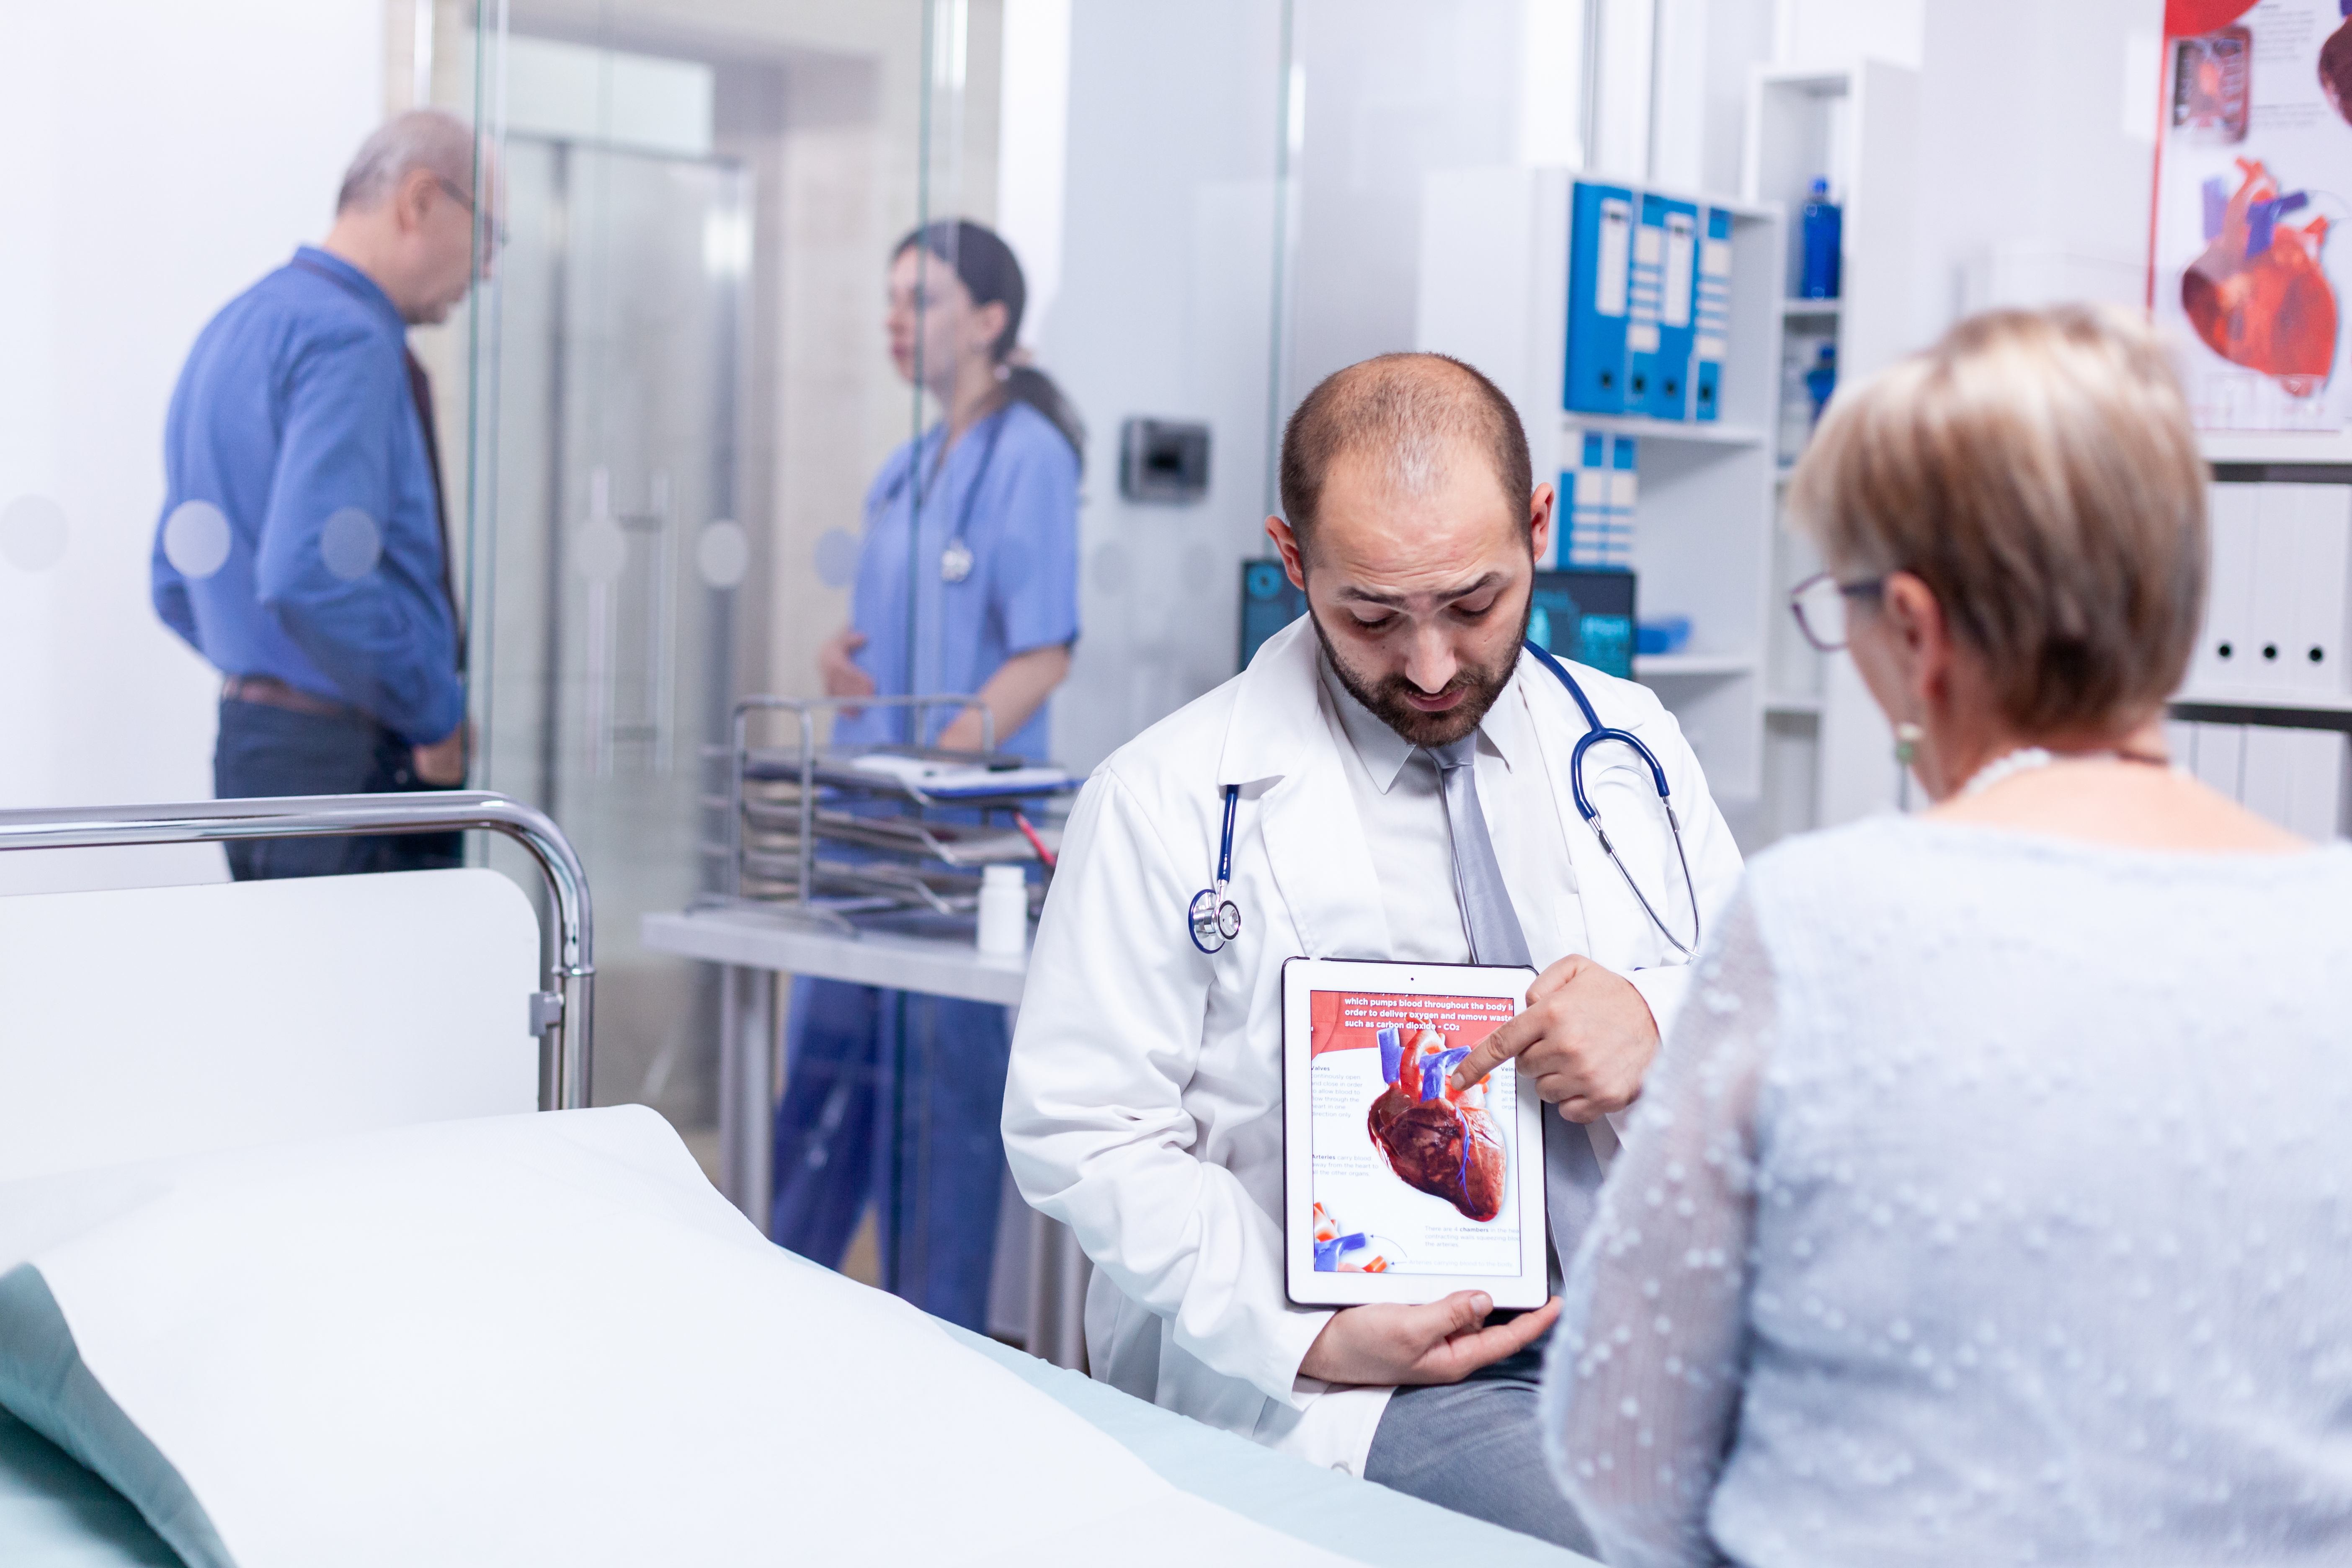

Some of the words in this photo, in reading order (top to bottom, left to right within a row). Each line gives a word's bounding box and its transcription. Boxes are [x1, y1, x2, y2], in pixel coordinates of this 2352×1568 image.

[1424, 1001, 1469, 1009] throughout
[1486, 1003, 1506, 1011] body
[1406, 1021, 1436, 1030] dioxide
